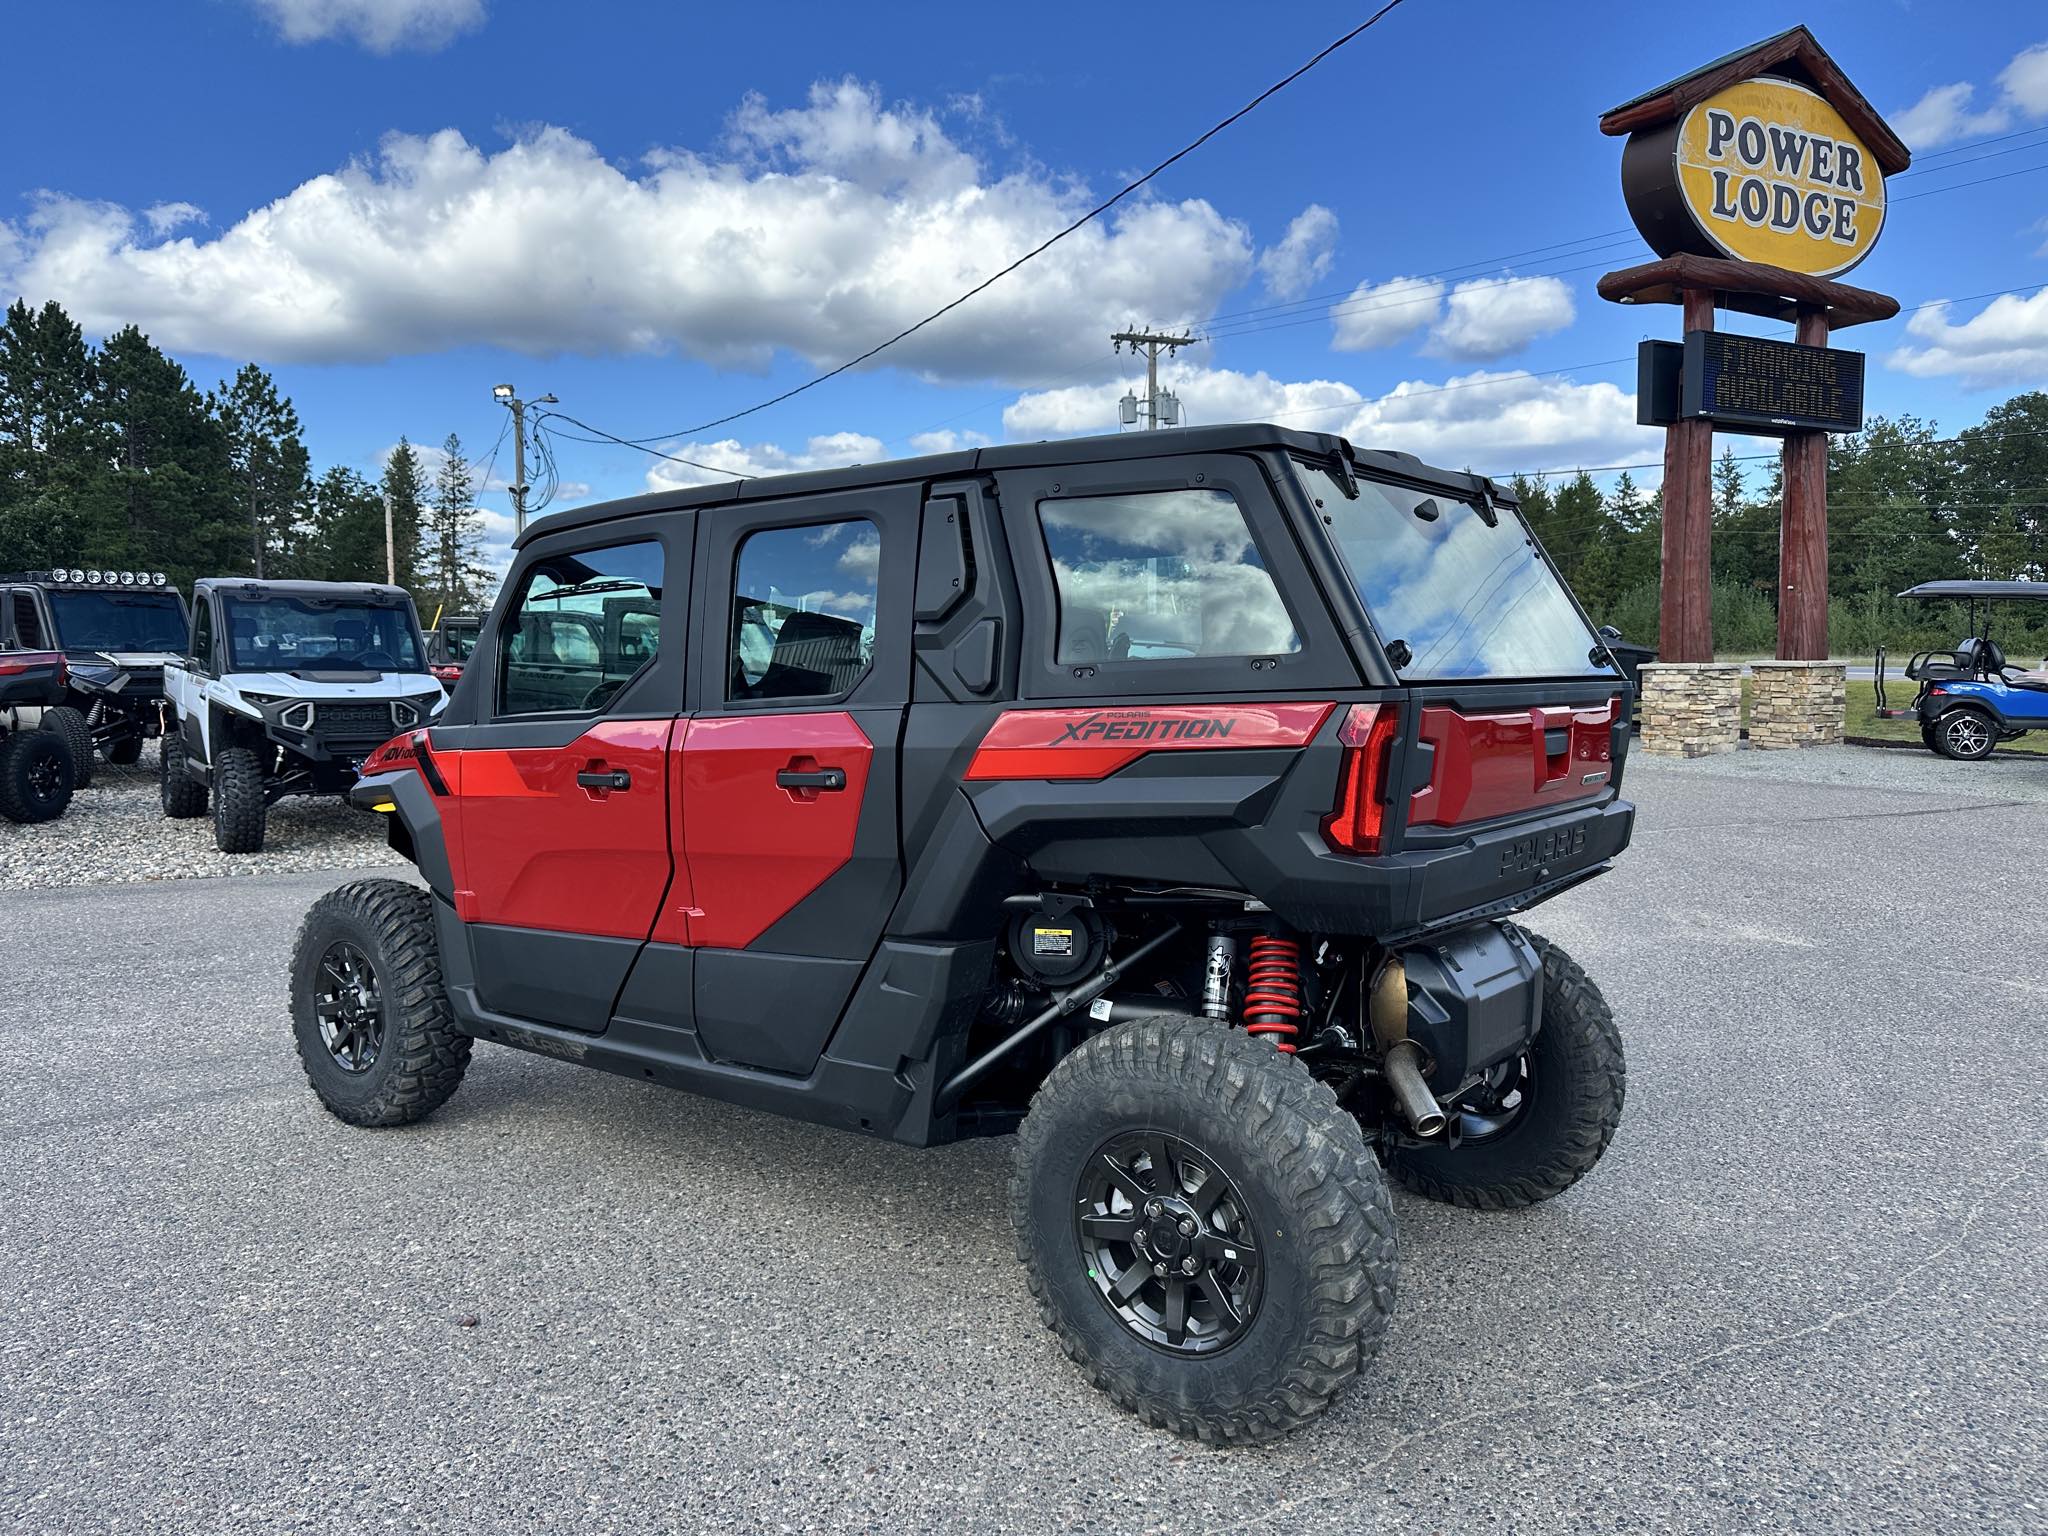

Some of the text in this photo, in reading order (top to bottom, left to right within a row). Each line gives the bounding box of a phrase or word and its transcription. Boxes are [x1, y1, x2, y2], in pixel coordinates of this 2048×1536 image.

[1708, 111, 1862, 191] POWER
[1712, 171, 1856, 242] LODGE
[1723, 338, 1837, 385] FINANCING
[1716, 374, 1843, 419] AVAILABLE
[318, 711, 387, 720] POLARIS
[1049, 713, 1236, 747] XPEDITION
[1106, 711, 1151, 719] POLARIS
[382, 747, 420, 761] ADV100
[1498, 824, 1587, 878] POLARIS
[505, 1030, 588, 1060] POLARIS
